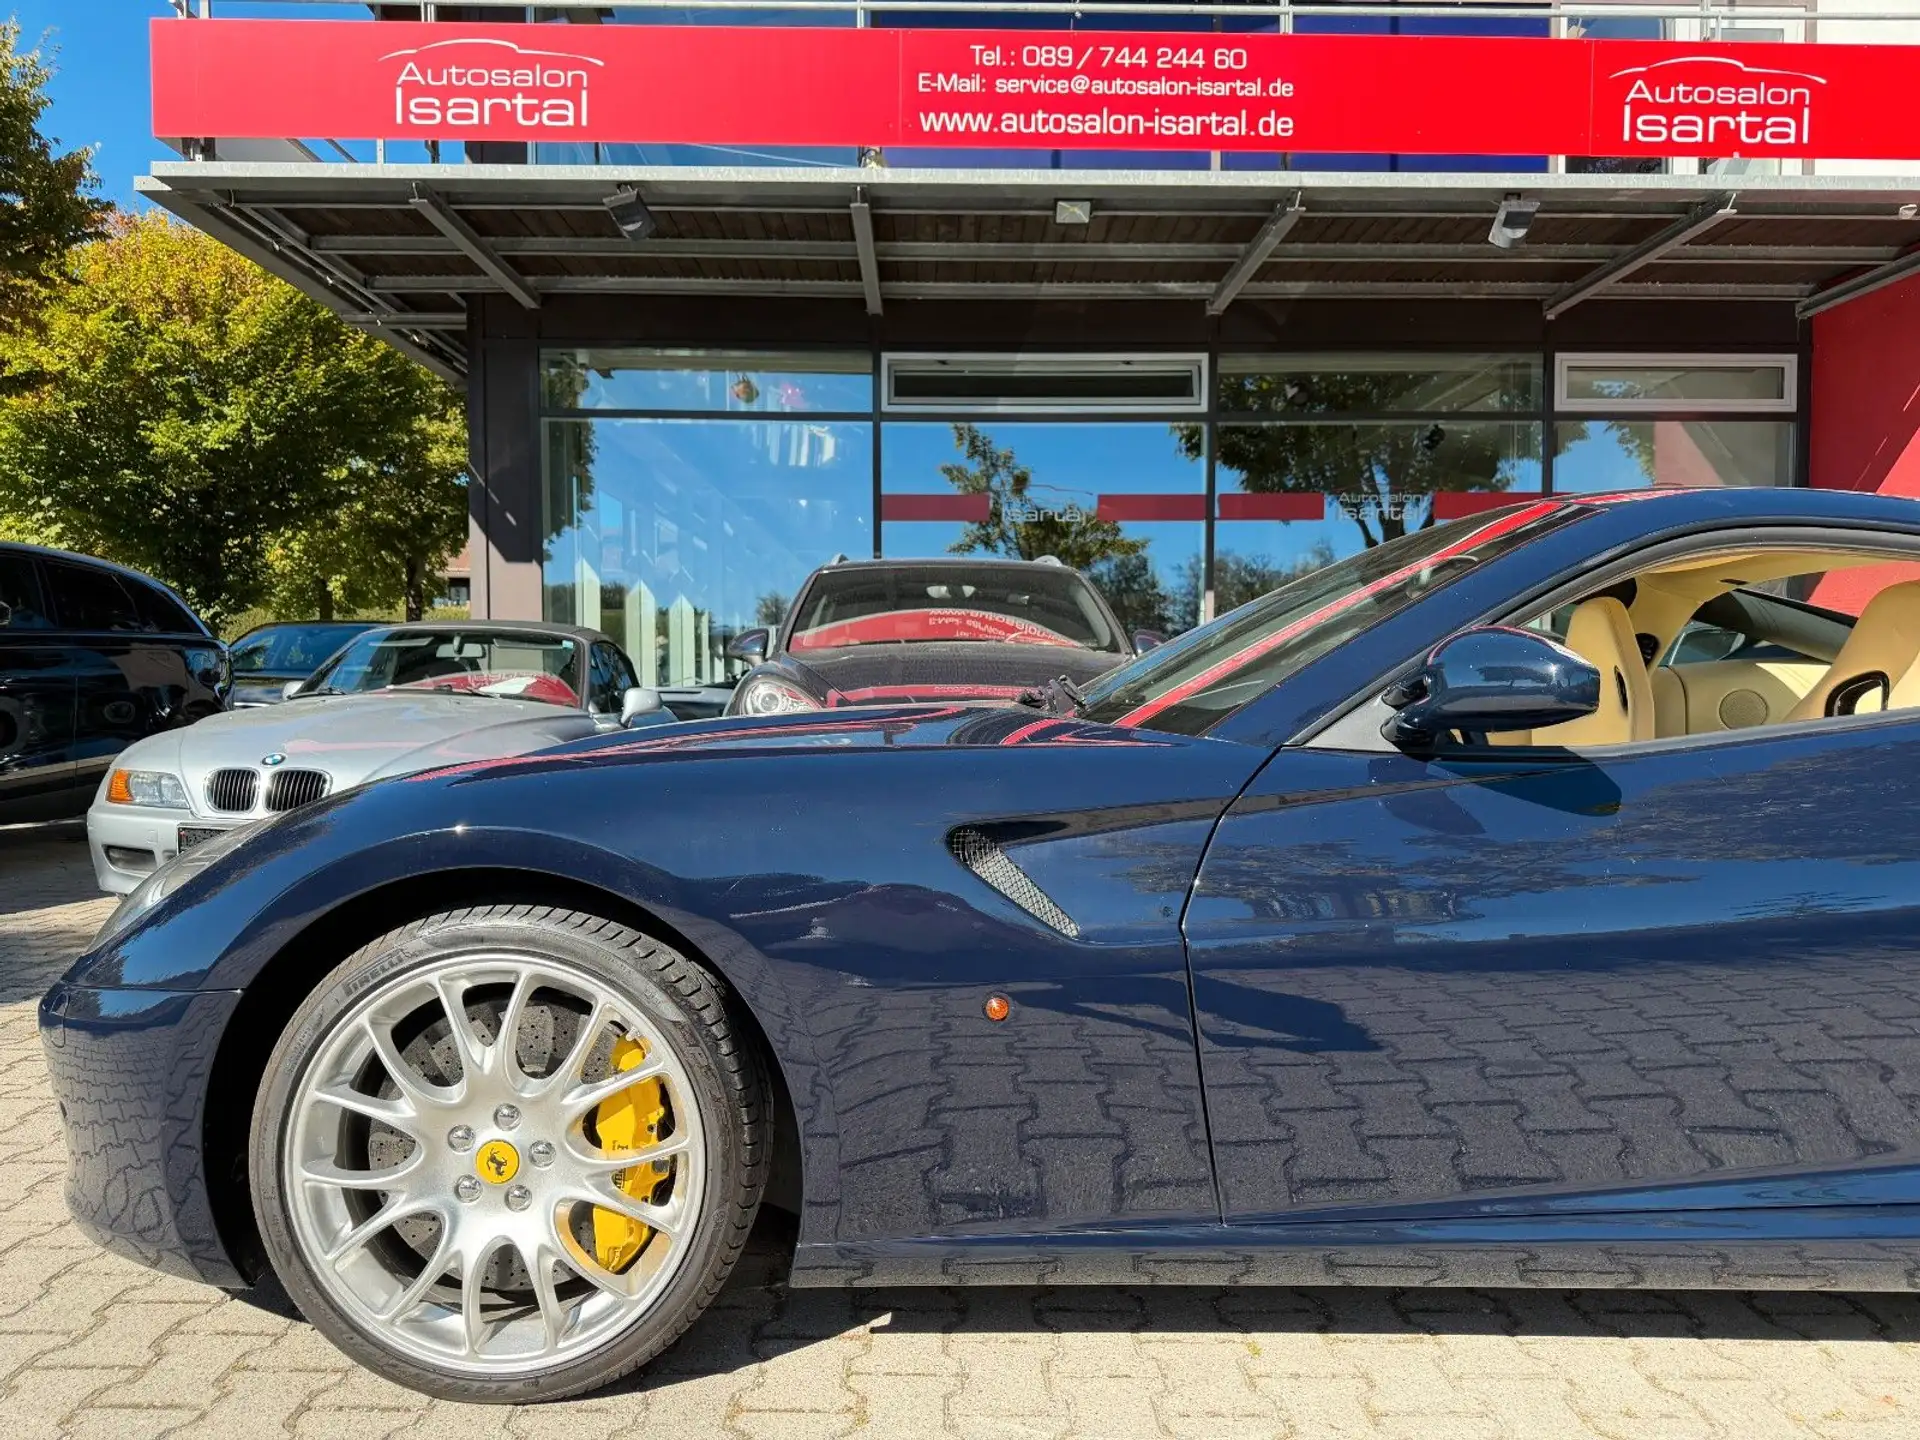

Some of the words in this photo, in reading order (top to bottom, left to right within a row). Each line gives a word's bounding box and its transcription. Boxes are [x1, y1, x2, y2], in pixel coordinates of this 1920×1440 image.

[969, 45, 1015, 66] Tel.:
[1022, 46, 1073, 67] 089
[1099, 46, 1148, 67] 744
[1156, 47, 1205, 68] 244
[1214, 48, 1247, 69] 60
[396, 61, 588, 88] Autosalon
[918, 72, 986, 92] E-Mail:
[995, 74, 1294, 97] service@autosalon-isartal.de
[1625, 79, 1810, 105] Autosalon
[395, 86, 588, 127] Isartal
[919, 107, 1294, 137] www.autosalon-isartal.de
[1623, 104, 1809, 144] Isartal
